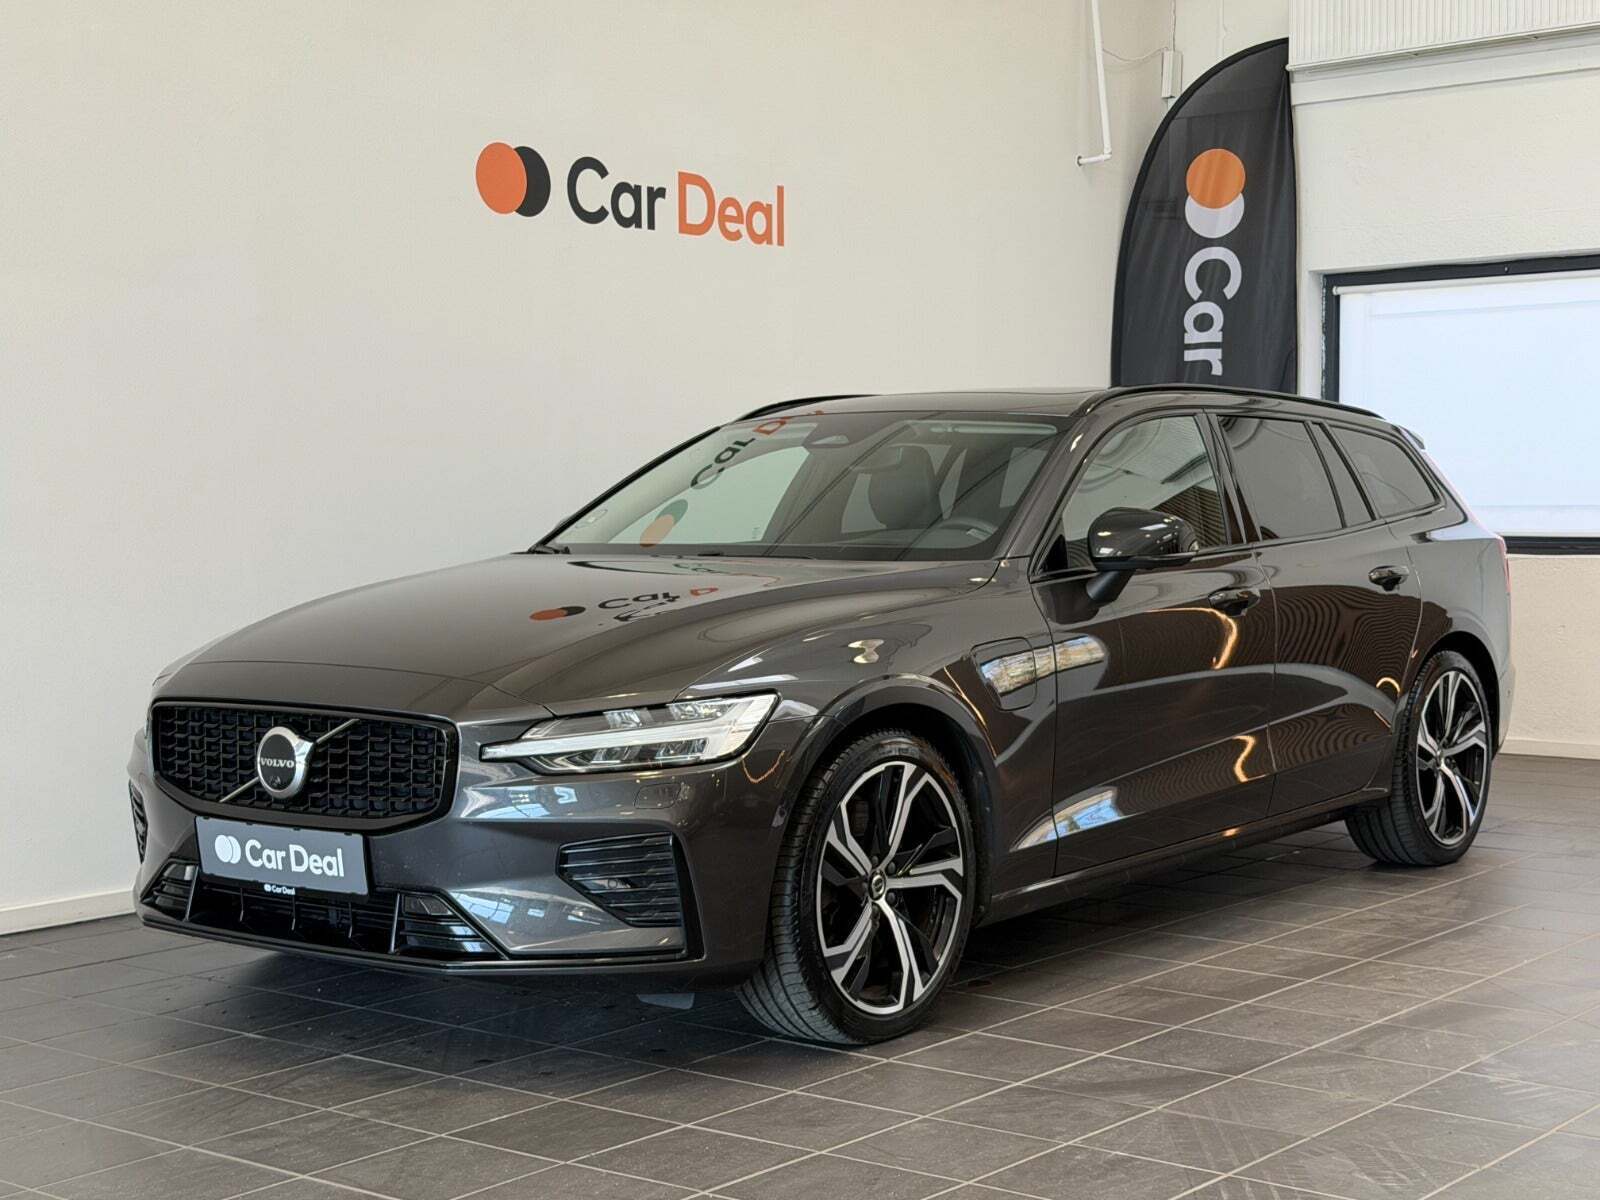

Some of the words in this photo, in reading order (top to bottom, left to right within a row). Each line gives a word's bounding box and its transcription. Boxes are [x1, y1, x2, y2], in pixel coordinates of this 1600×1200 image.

[567, 156, 666, 231] Car
[678, 171, 785, 247] Deal
[1183, 246, 1242, 376] Car
[260, 757, 295, 769] VOLVO
[245, 839, 286, 870] Car
[289, 844, 345, 877] Deal
[271, 884, 282, 893] Car
